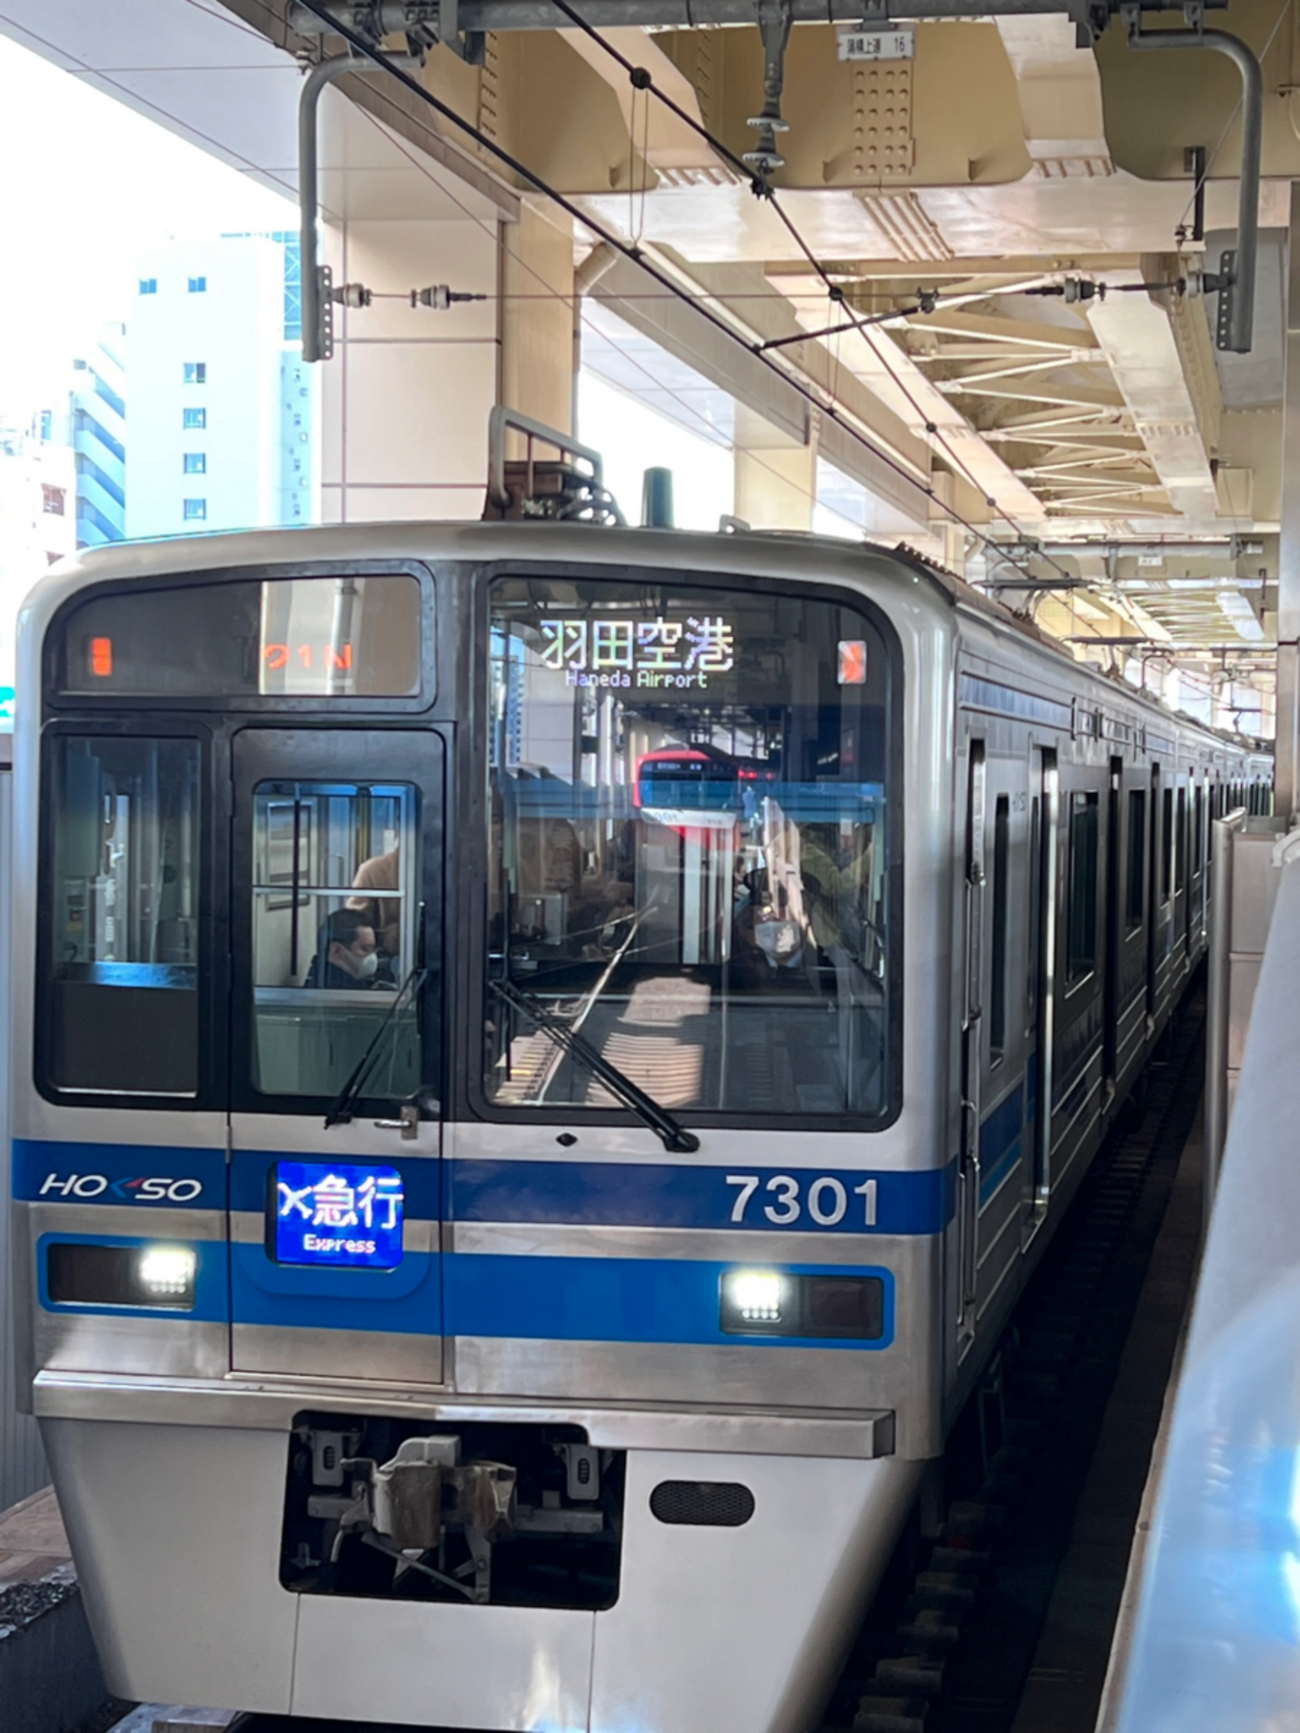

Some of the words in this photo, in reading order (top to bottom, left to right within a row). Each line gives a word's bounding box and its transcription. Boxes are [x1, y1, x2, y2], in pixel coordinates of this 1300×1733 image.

[894, 35, 906, 53] 16
[540, 616, 734, 672] 羽田空港
[565, 670, 631, 688] Haneda
[637, 670, 708, 688] Airport
[725, 1175, 878, 1226] 7301
[303, 1233, 376, 1255] Express
